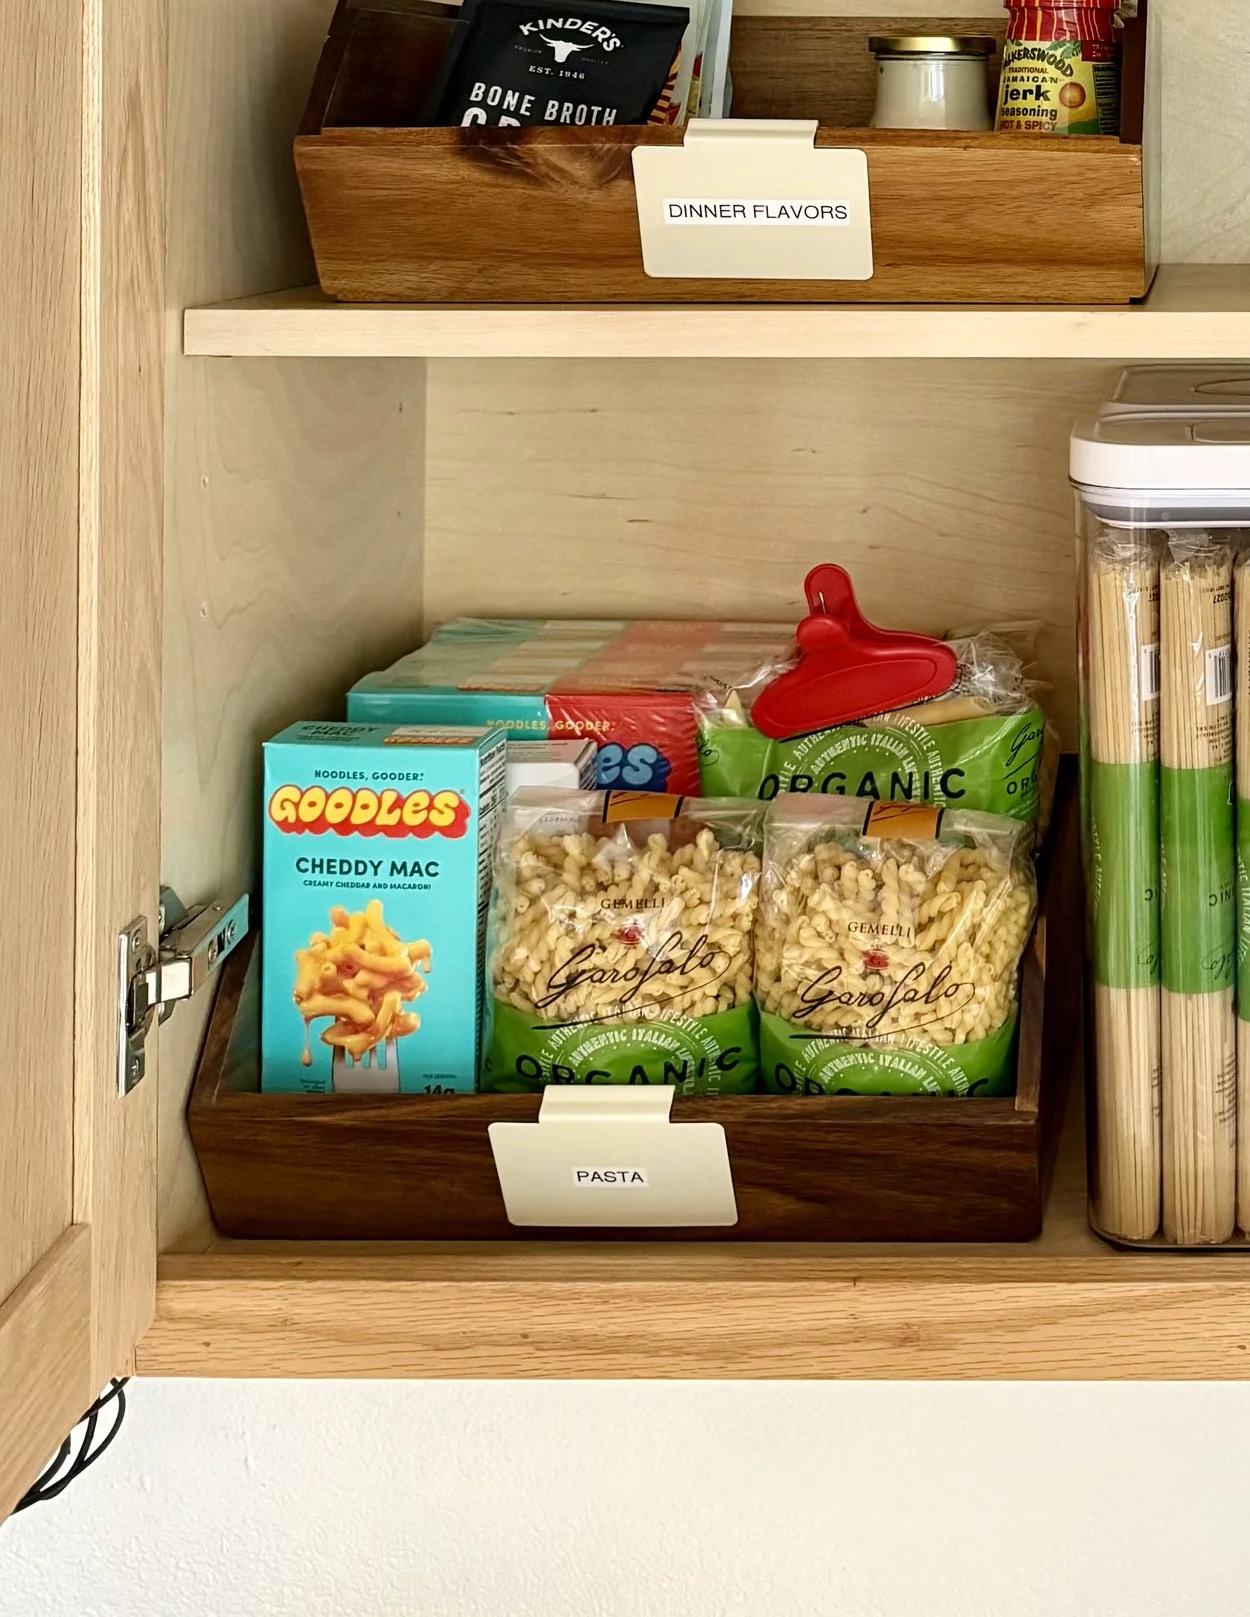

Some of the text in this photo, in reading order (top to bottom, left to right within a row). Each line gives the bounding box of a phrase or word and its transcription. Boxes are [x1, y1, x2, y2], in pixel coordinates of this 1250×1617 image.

[519, 17, 621, 52] KINDER'S
[529, 65, 585, 80] EST. 1946
[470, 82, 535, 116] BONE
[544, 100, 617, 126] BROTH
[1003, 84, 1051, 105] jerk
[1001, 105, 1058, 121] seasoning
[1024, 119, 1057, 132] SPICY
[669, 204, 848, 219] DINNER FLAVORS
[315, 770, 368, 781] NOODLES,
[758, 768, 966, 801] ORGANIC
[295, 857, 440, 878] CHEDDY MAC
[303, 880, 333, 888] CREAMY
[335, 881, 370, 889] CHEDDAR
[390, 883, 431, 891] MACARONI
[600, 897, 665, 909] GEMELLI
[847, 921, 912, 938] GEMELLI
[534, 931, 727, 1014] Garofalo
[791, 962, 971, 1032] Garofalo
[568, 1029, 680, 1066] AUTHENTIC ITALIAN
[819, 1053, 875, 1084] AUTHENTIC
[879, 1053, 926, 1080] ITALIAN
[577, 1170, 644, 1183] PASTA
